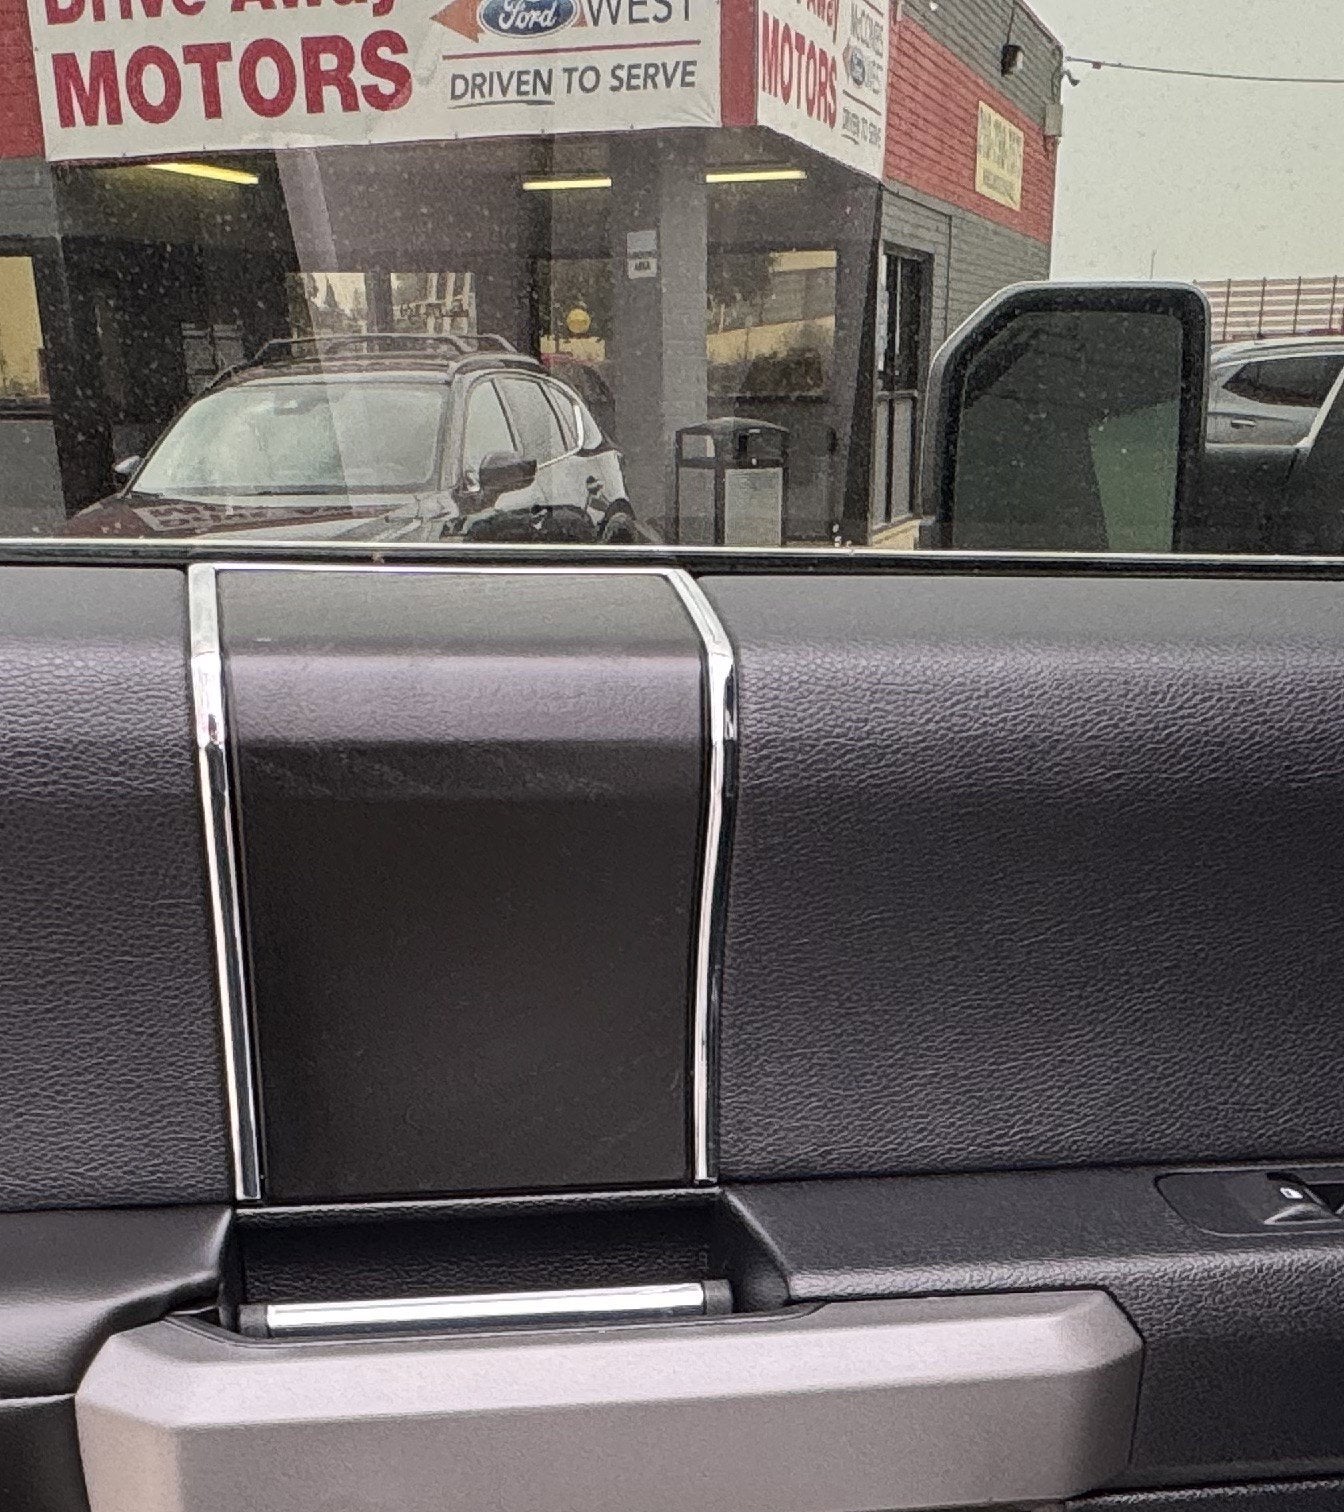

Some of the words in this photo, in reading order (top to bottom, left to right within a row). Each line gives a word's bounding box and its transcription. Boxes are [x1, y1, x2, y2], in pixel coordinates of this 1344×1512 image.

[498, 0, 557, 29] Ford
[51, 30, 413, 128] MOTORS
[450, 68, 553, 100] DRIVEN
[563, 65, 602, 94] TO
[609, 60, 698, 92] SERVE
[762, 10, 837, 130] MOTORS
